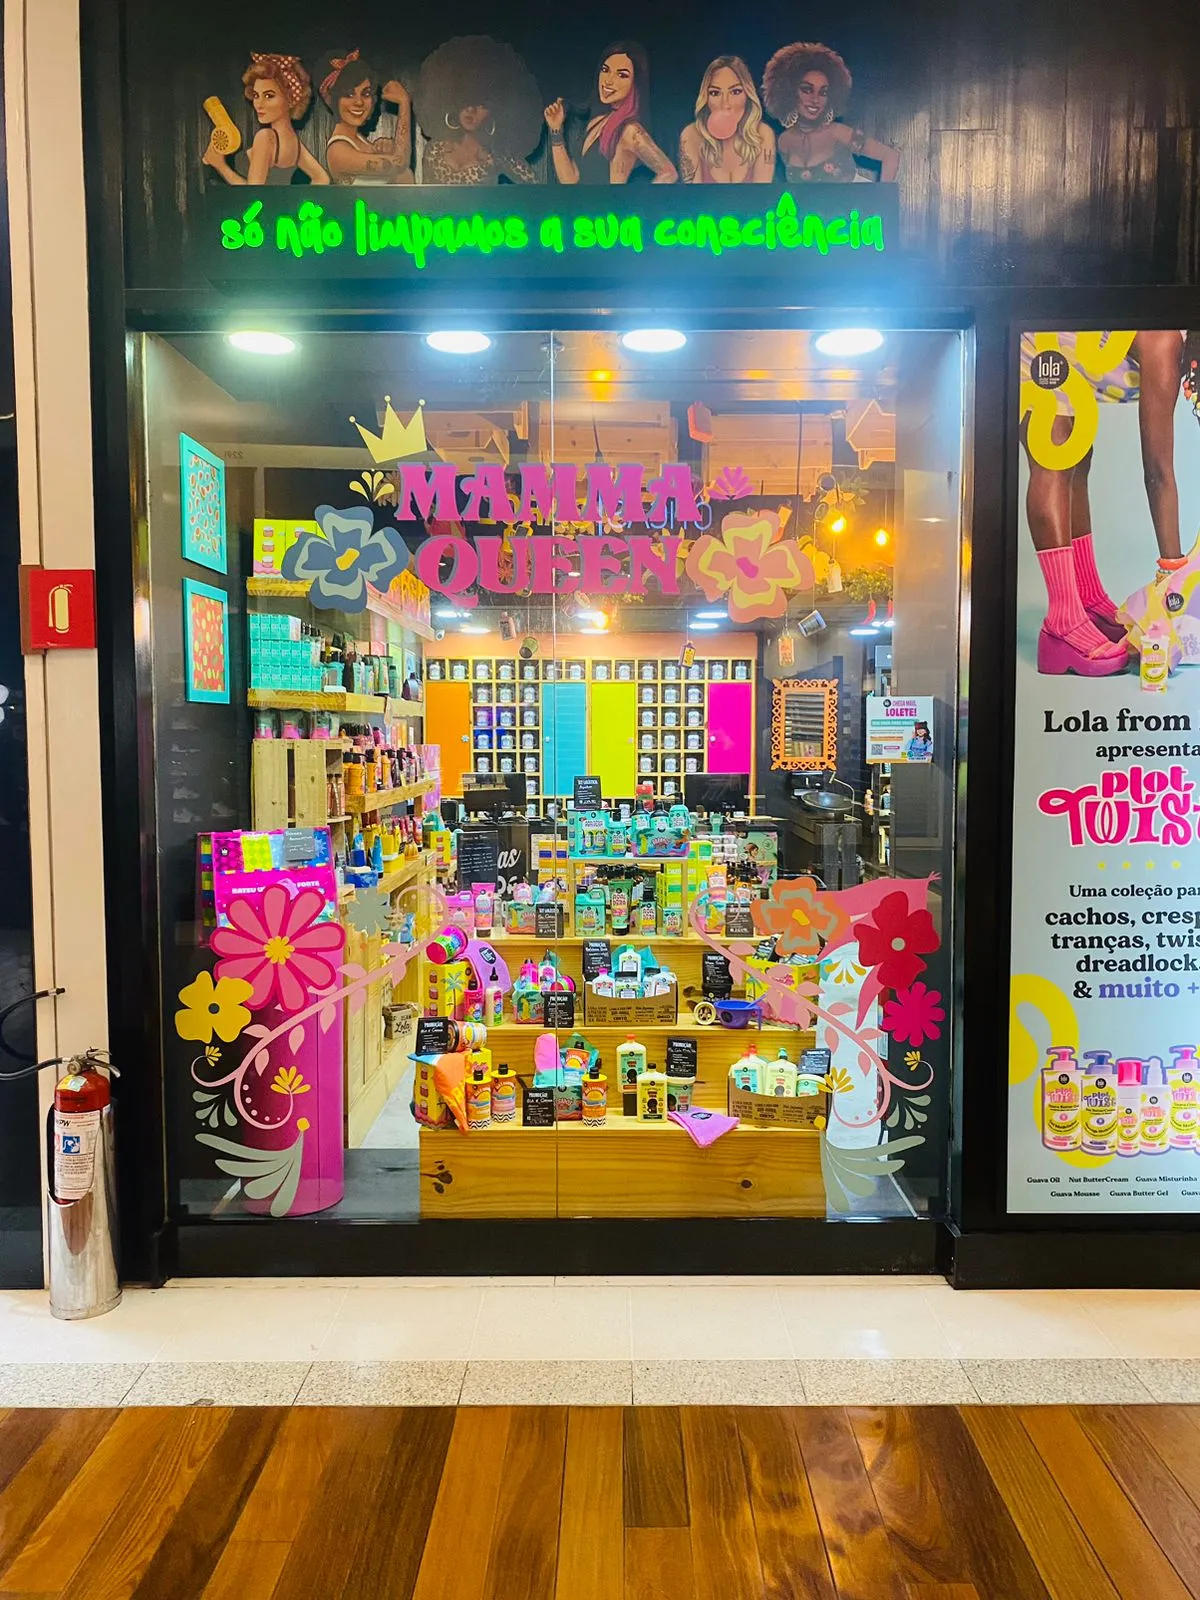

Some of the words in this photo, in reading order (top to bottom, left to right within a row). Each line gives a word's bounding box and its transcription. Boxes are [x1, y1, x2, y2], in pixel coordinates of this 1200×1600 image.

[220, 201, 264, 249] só
[276, 202, 342, 257] não
[355, 199, 528, 268] limpamos
[539, 216, 564, 252] a
[573, 213, 643, 252] sua
[653, 191, 883, 254] consciência
[1038, 356, 1060, 377] lola
[397, 462, 702, 522] MAMMA
[414, 535, 683, 608] QUEEN
[886, 708, 917, 717] LOLETE!
[1043, 709, 1109, 733] Lola
[1116, 708, 1192, 732] from
[1095, 742, 1200, 762] apresenta
[1101, 765, 1196, 805] plot
[1069, 884, 1107, 898] Uma
[1111, 884, 1173, 900] coleção
[1045, 907, 1136, 928] cachos,
[1051, 933, 1150, 954] tranças,
[1075, 954, 1200, 972] dreadlock
[1073, 980, 1092, 999] &
[1098, 976, 1180, 998] muito
